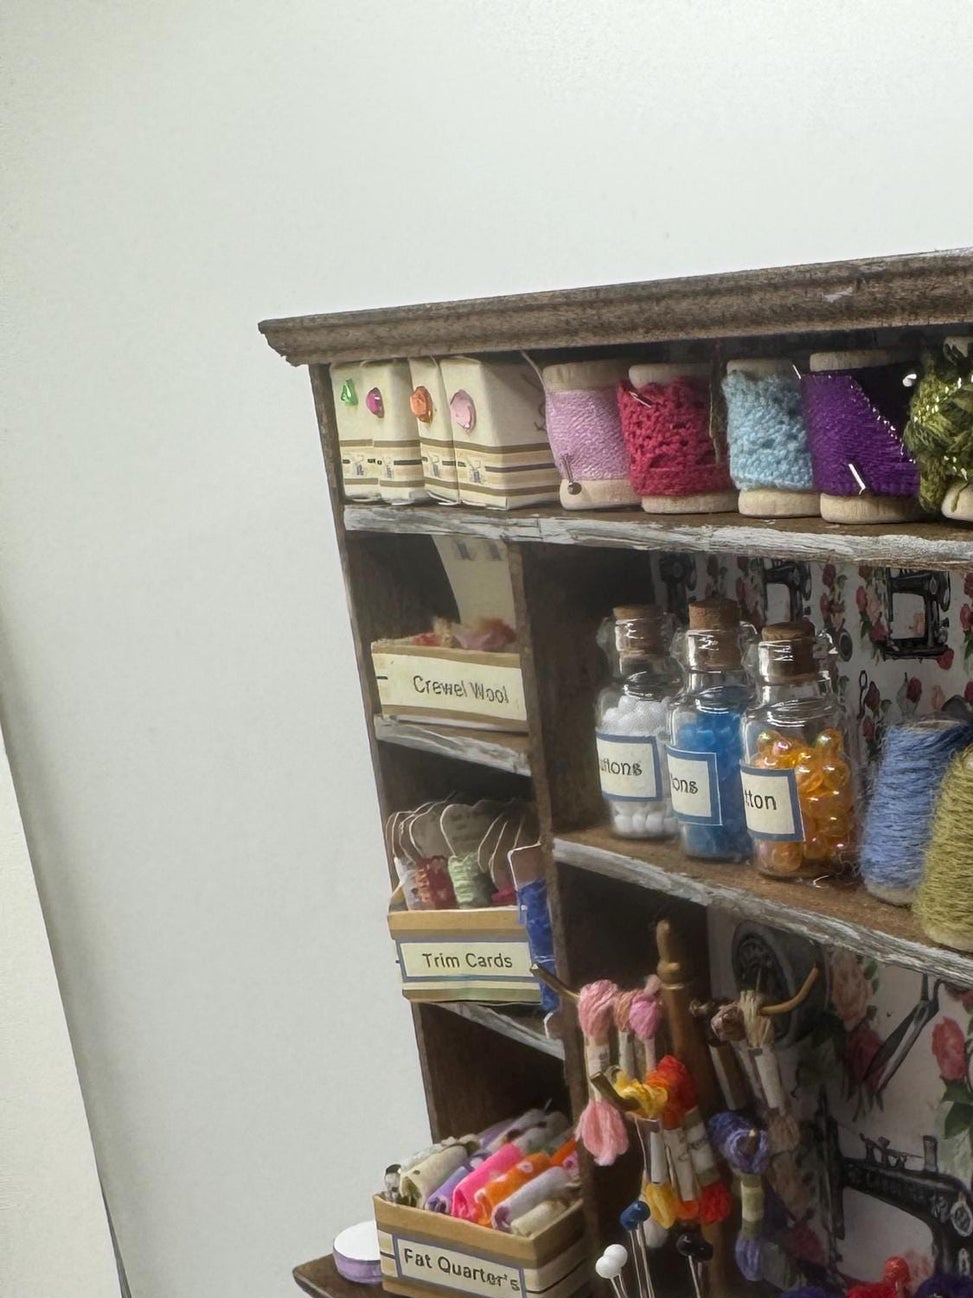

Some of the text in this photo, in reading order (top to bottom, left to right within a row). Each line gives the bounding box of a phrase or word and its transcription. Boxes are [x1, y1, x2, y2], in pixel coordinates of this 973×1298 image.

[413, 675, 509, 705] Crewel Wool
[422, 952, 513, 968] Trim Cards
[403, 1248, 520, 1291] Fat Quarter's
